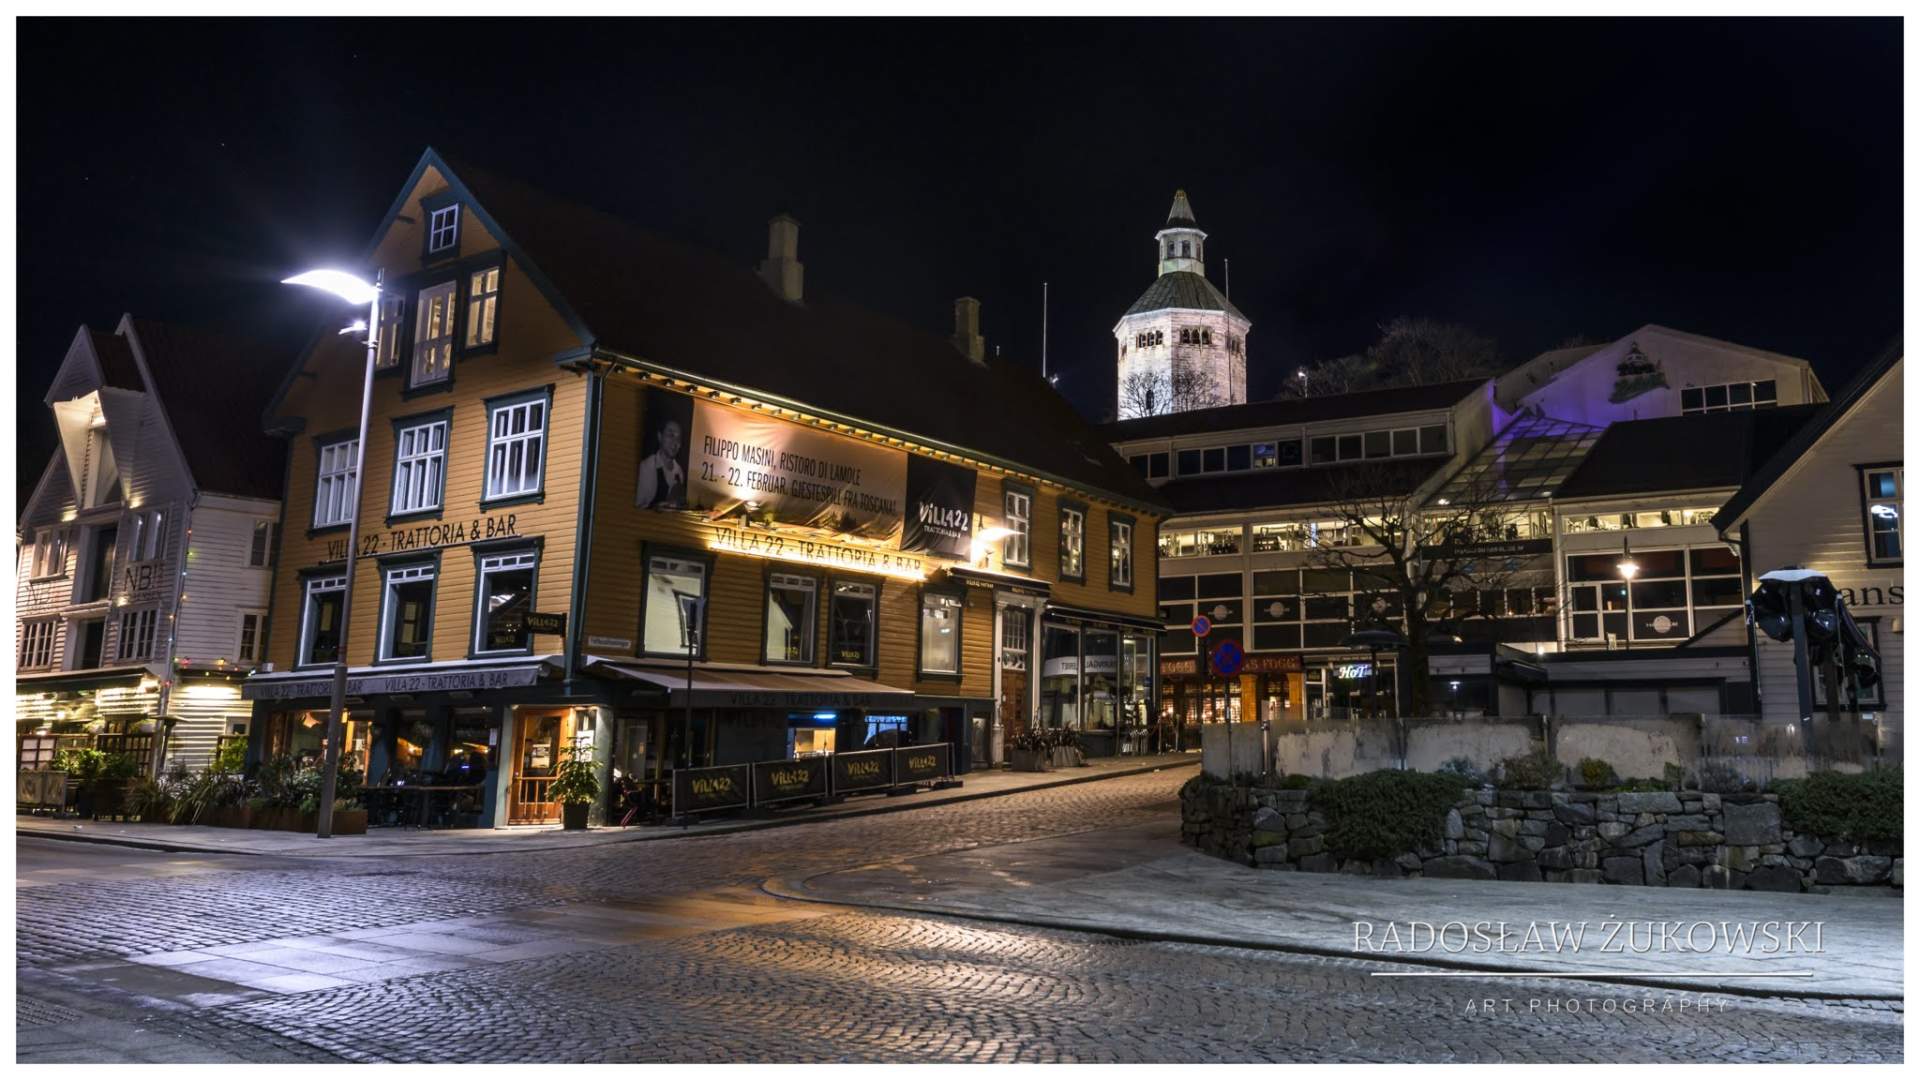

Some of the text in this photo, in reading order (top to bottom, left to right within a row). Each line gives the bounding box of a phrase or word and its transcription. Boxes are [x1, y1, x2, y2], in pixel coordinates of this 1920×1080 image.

[704, 436, 861, 486] FILIPPO MASINI, RISTORO DI LAMOLE
[701, 461, 718, 482] 21.
[728, 467, 743, 487] 22.
[843, 491, 858, 507] FRA
[362, 534, 379, 555] 22
[391, 522, 464, 550] TRATTORIA
[470, 519, 480, 541] &
[486, 514, 516, 538] BAR
[715, 527, 760, 553] VILLA
[764, 535, 784, 556] 22
[798, 540, 876, 570] TRATTORIA
[385, 678, 406, 691] VILLA
[409, 677, 421, 691] 22
[428, 675, 475, 690] TRATTORIA
[489, 672, 508, 687] BAR
